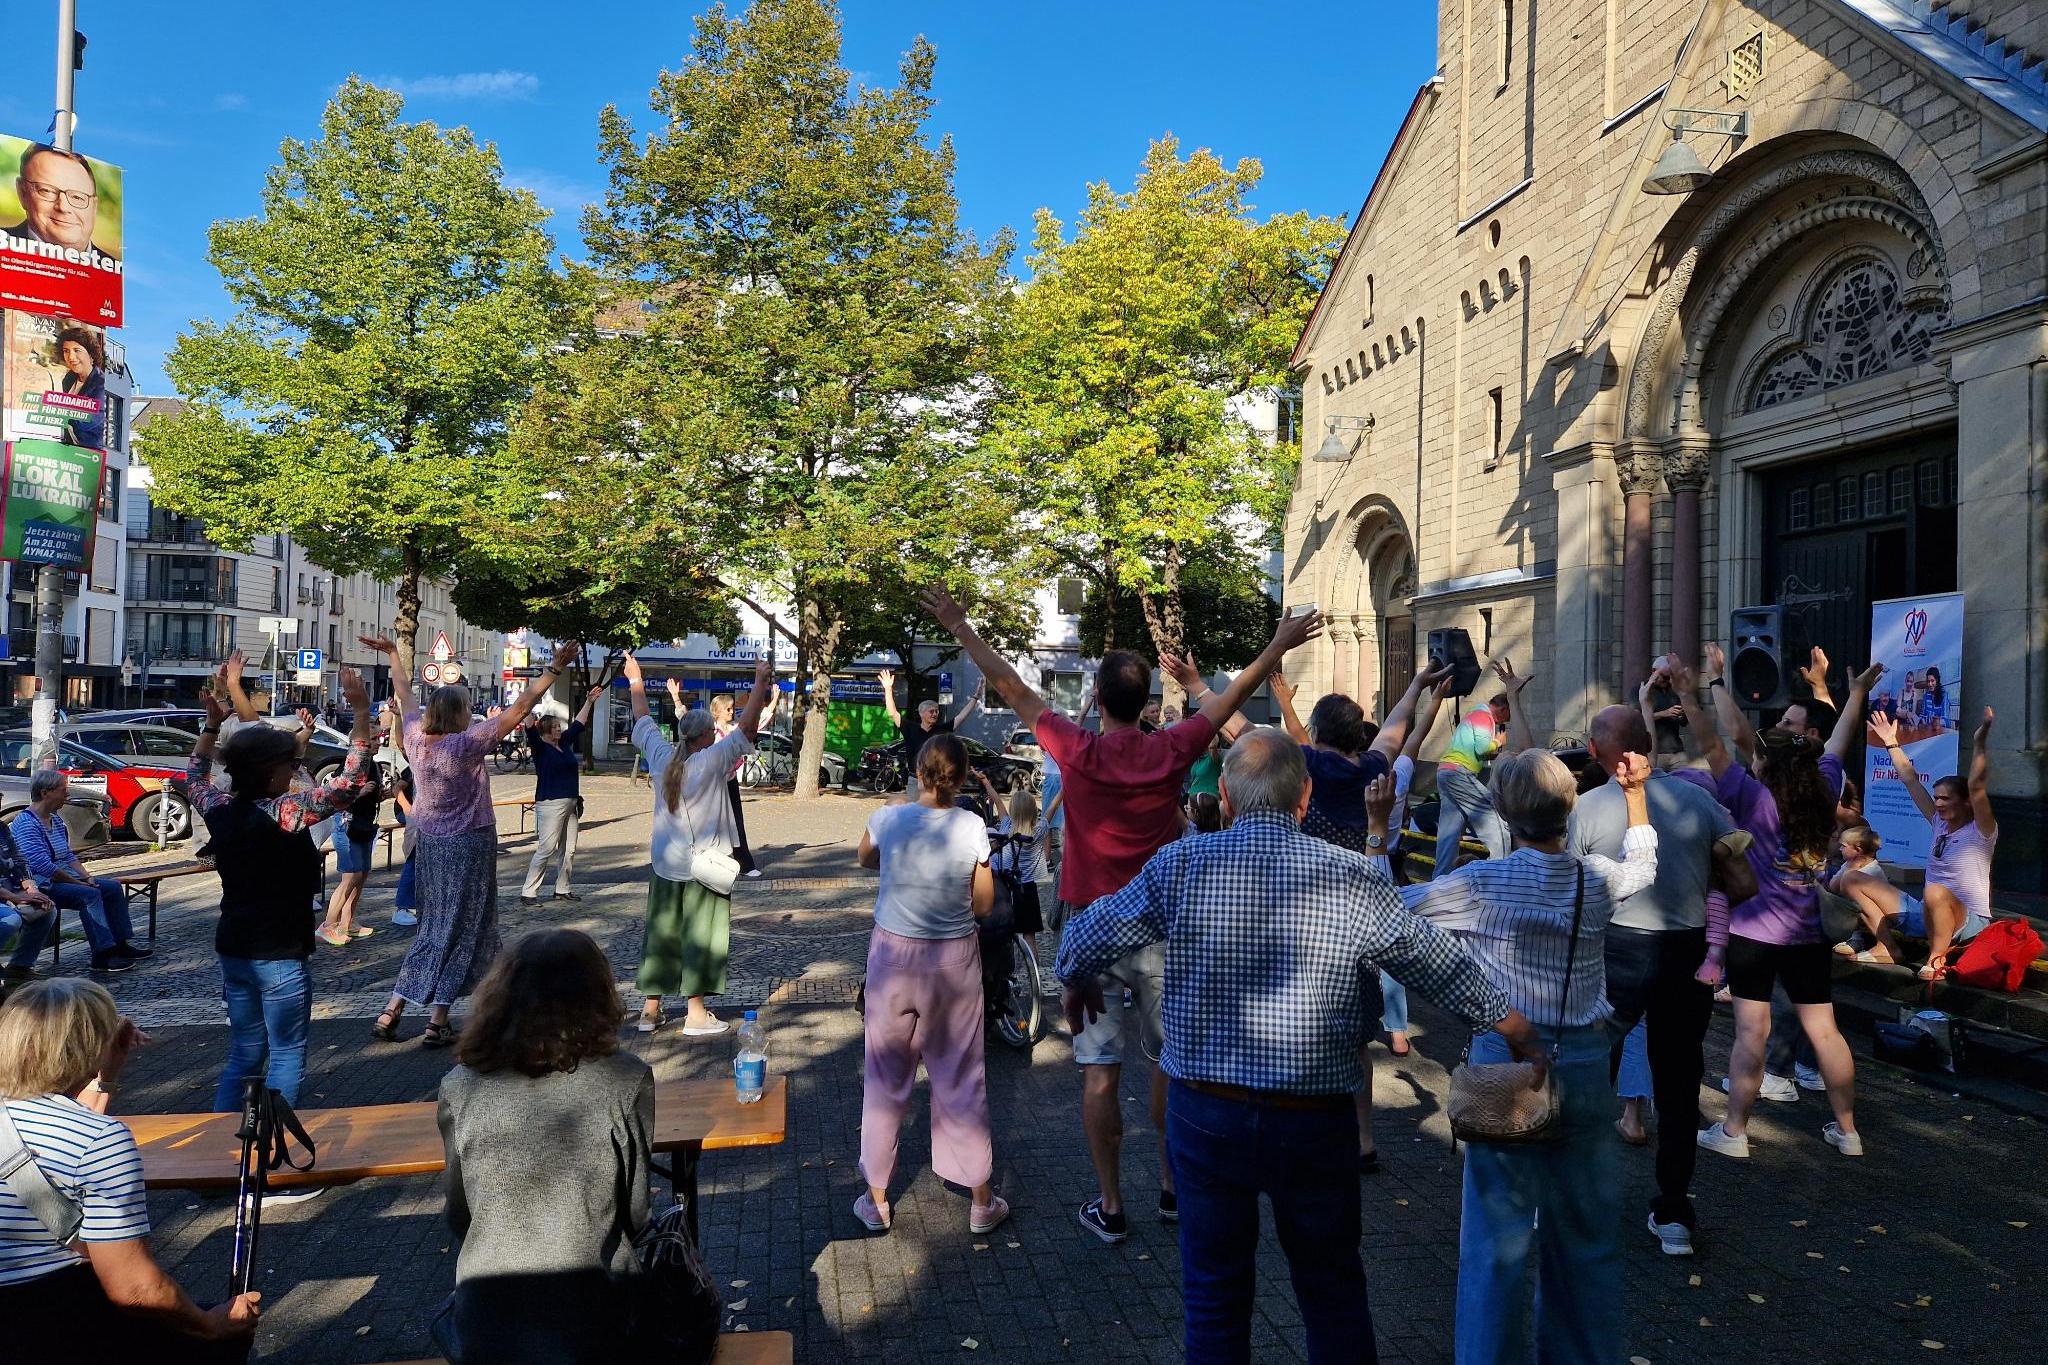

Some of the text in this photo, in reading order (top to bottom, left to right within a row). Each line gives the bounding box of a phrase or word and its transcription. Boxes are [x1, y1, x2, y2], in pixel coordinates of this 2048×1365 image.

[100, 308, 116, 318] SPD
[26, 394, 40, 402] MIT
[30, 414, 44, 423] MIT
[42, 405, 89, 420] FÜR DIE STADT
[15, 453, 84, 474] MIT UNS WIRD
[13, 463, 82, 493] LOKAL
[11, 482, 94, 512] LUKRATIV.
[25, 526, 50, 537] Jetzt
[24, 537, 68, 550] Am 28.09.
[23, 546, 56, 559] AYMAZ
[303, 651, 317, 668] P
[708, 649, 736, 659] rund
[740, 651, 757, 659] um
[427, 667, 437, 677] 30
[726, 681, 741, 689] First
[1872, 767, 1885, 782] für
[248, 1107, 256, 1128] LEKI
